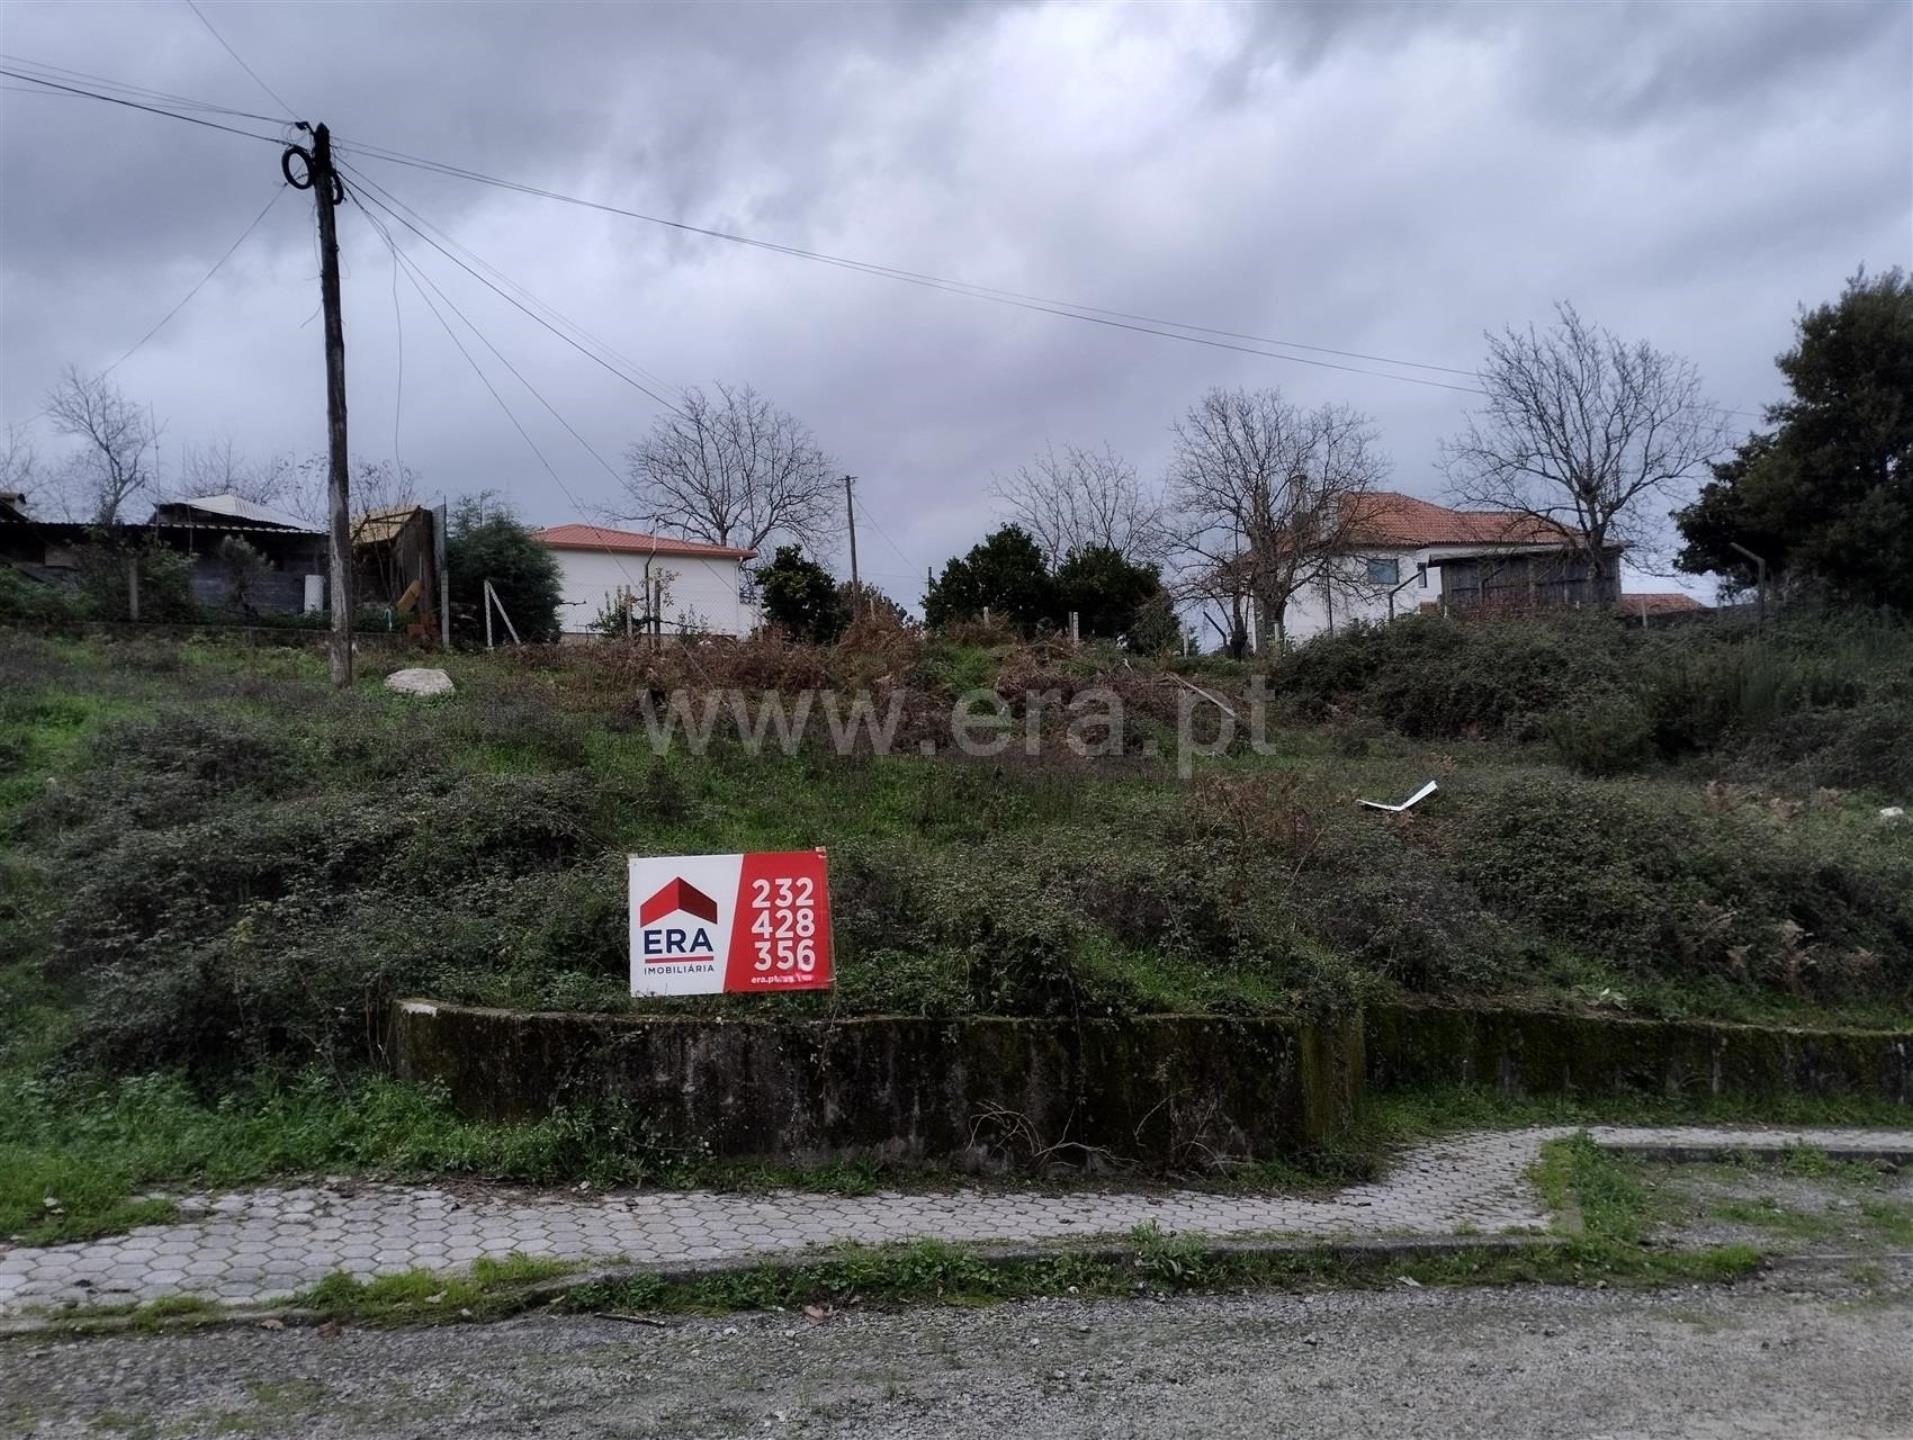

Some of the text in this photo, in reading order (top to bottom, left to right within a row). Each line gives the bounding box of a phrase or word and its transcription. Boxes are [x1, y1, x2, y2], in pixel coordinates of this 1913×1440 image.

[752, 877, 814, 908] 232
[751, 908, 815, 939] 428
[644, 928, 714, 955] ERA
[754, 939, 815, 972] 356
[644, 964, 714, 975] IMOBILIÁRIA
